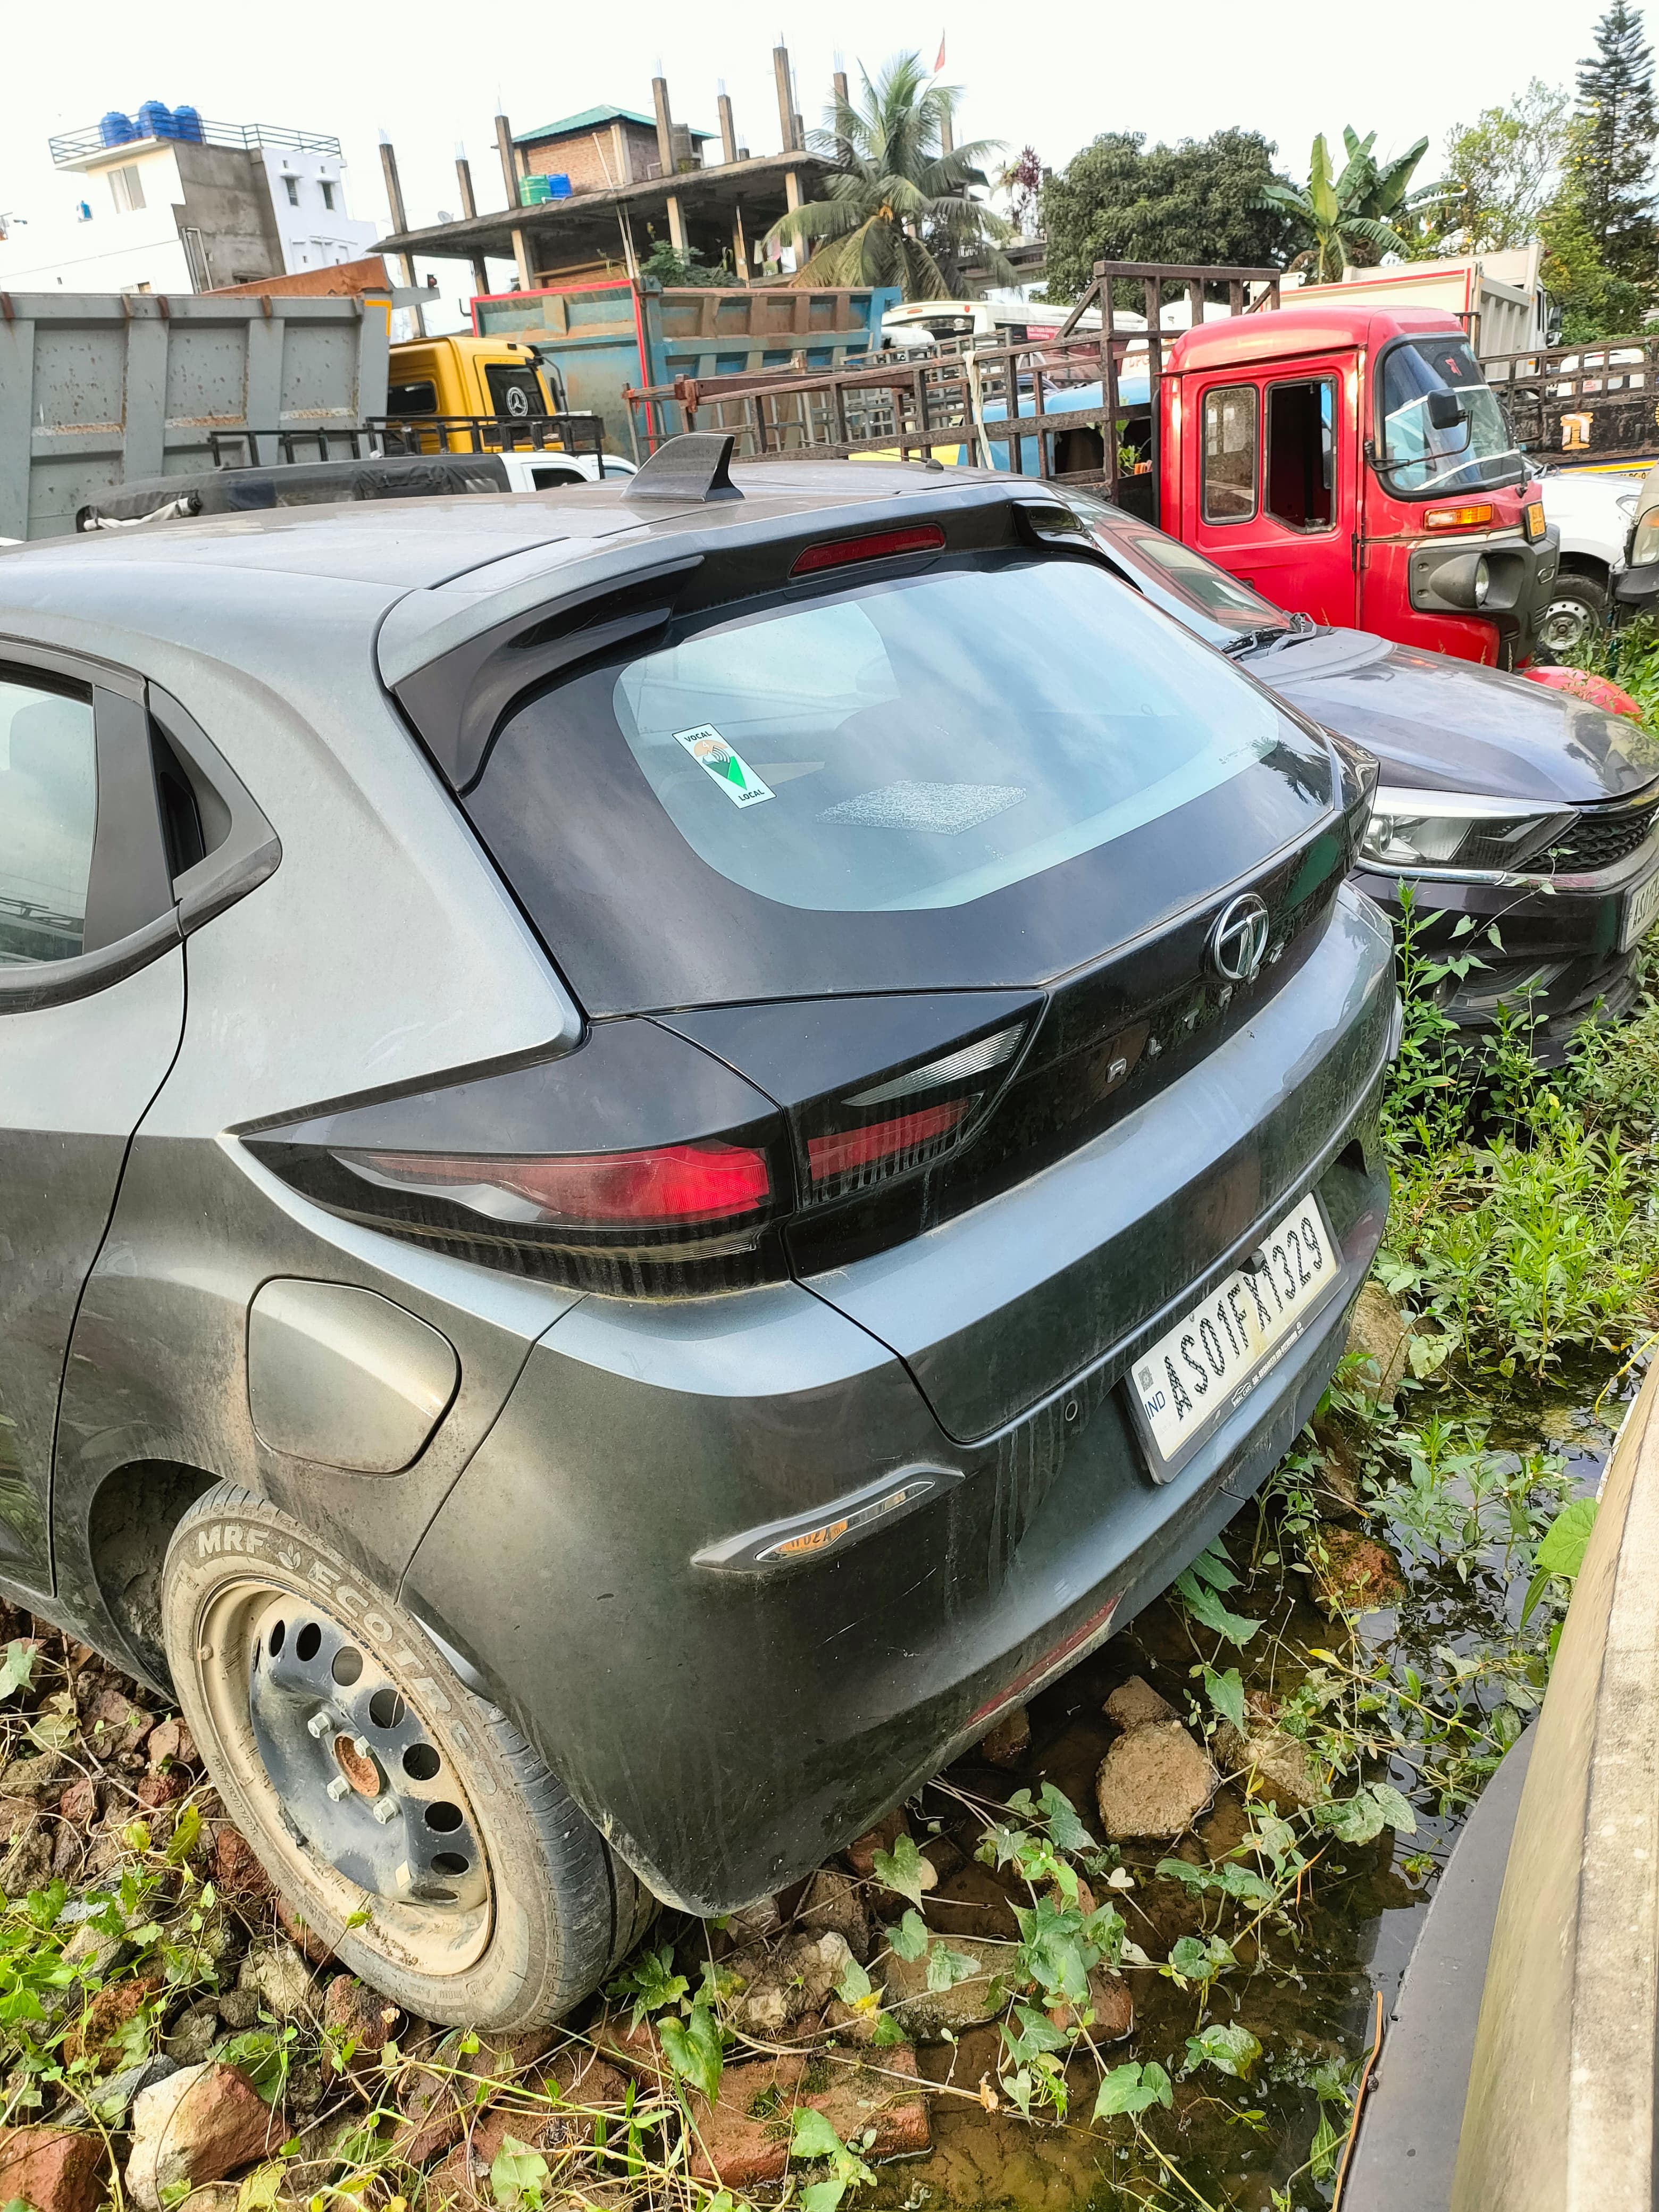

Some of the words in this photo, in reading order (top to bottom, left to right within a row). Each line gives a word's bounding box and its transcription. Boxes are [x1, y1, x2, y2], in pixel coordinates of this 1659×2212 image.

[684, 731, 712, 742] VOCAL
[738, 789, 765, 801] LOCAL
[1163, 1216, 1323, 1422] AS01FX1329
[1144, 1390, 1166, 1420] IND
[198, 1524, 270, 1558] MRF
